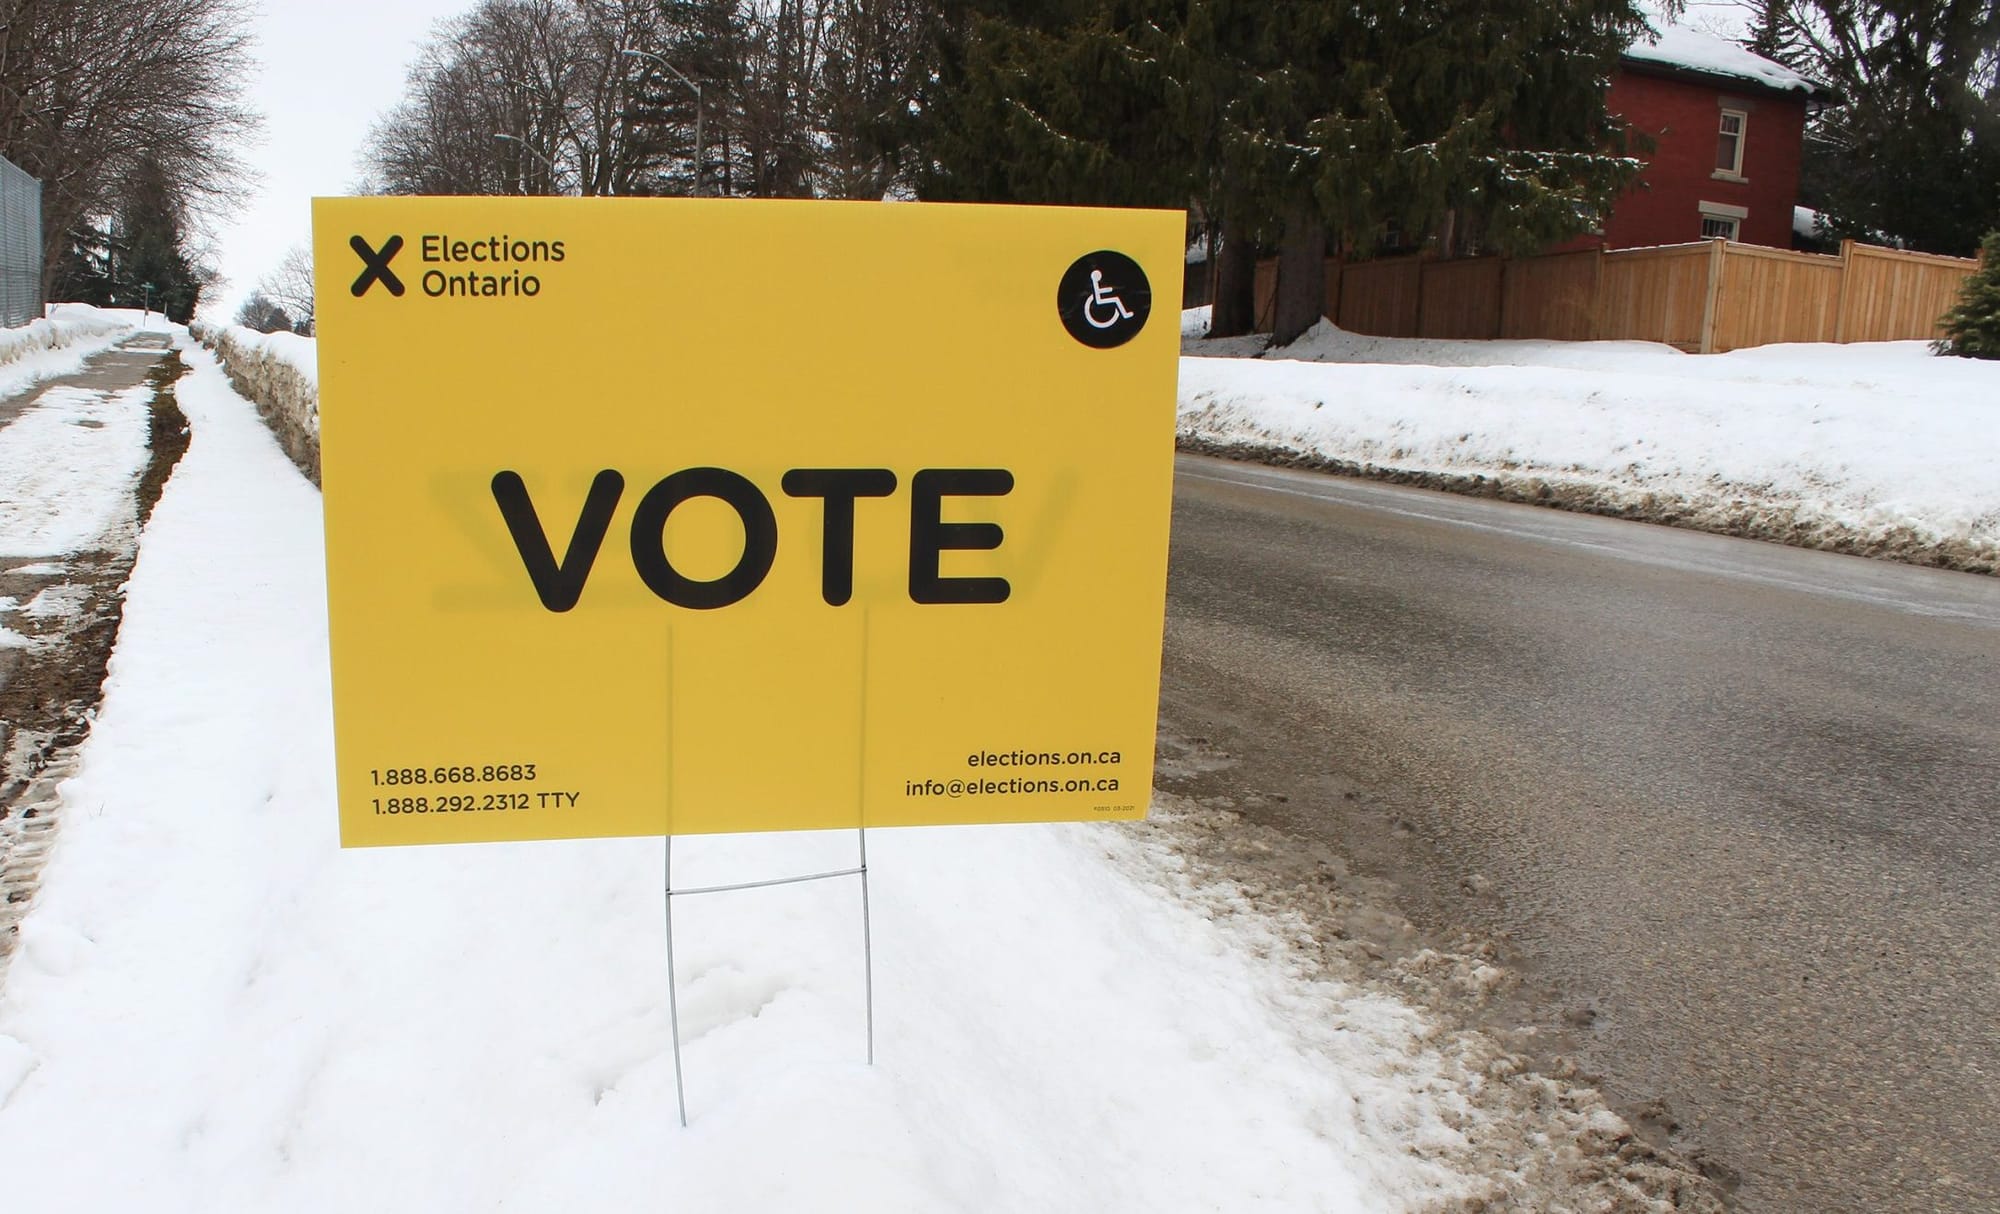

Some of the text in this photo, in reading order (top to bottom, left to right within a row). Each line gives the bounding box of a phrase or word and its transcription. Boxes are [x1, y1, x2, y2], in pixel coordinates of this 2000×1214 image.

[422, 234, 566, 262] Elections
[422, 269, 541, 298] Ontario
[491, 467, 1015, 614] VOTE
[967, 749, 1121, 768] elections.on.ca
[371, 763, 537, 786] 1.888.668.8683
[906, 777, 1119, 799] info@elections.on.ca
[372, 791, 580, 815] 1.888.292.2312 TTY
